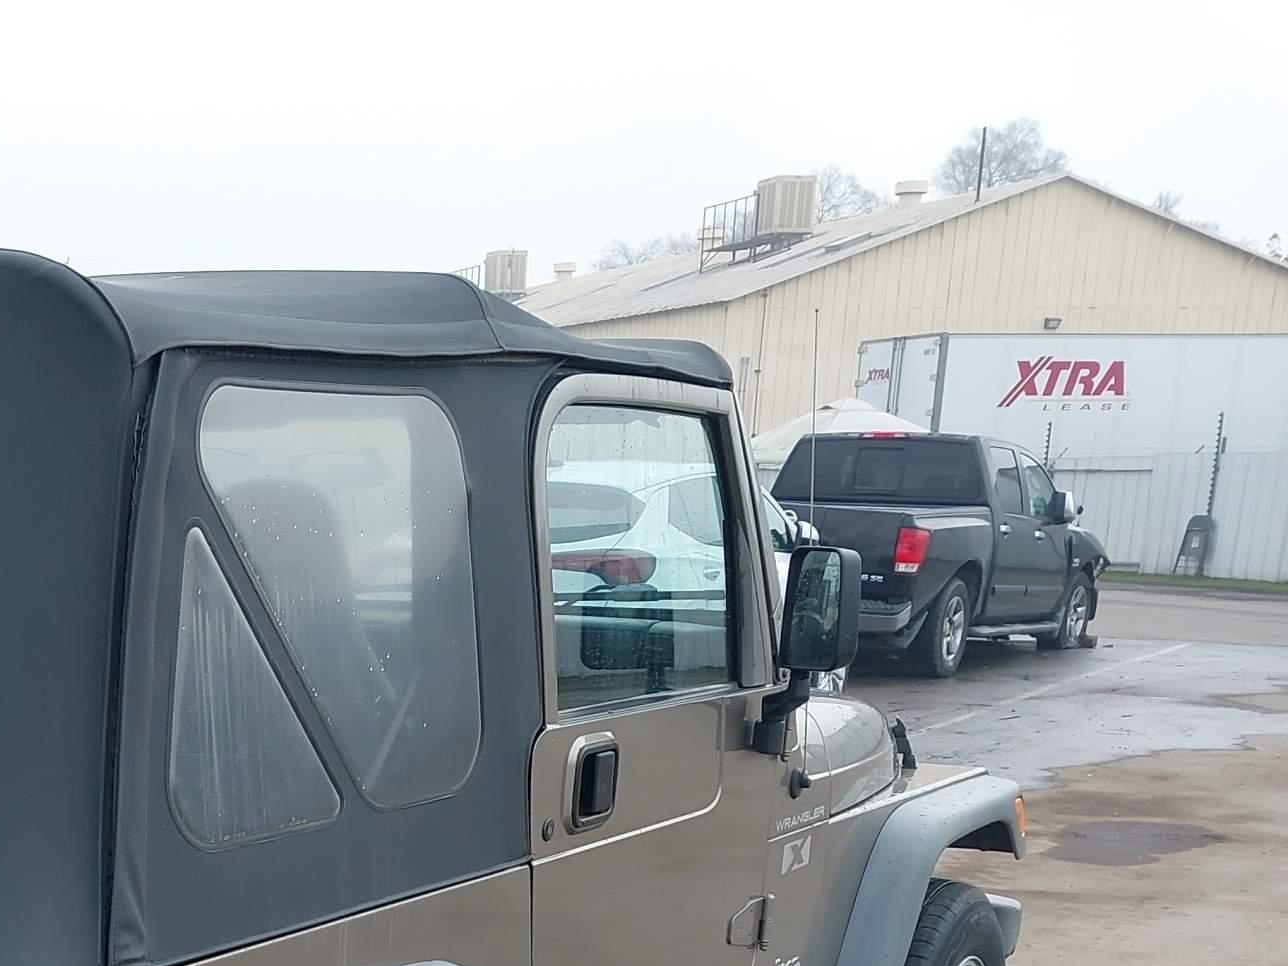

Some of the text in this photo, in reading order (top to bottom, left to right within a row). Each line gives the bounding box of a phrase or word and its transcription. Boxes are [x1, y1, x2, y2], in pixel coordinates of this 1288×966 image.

[865, 368, 890, 384] XTRA
[997, 355, 1125, 408] XTRA
[1042, 403, 1132, 411] LEASE
[776, 805, 825, 831] WRANGLER
[781, 835, 812, 875] X
